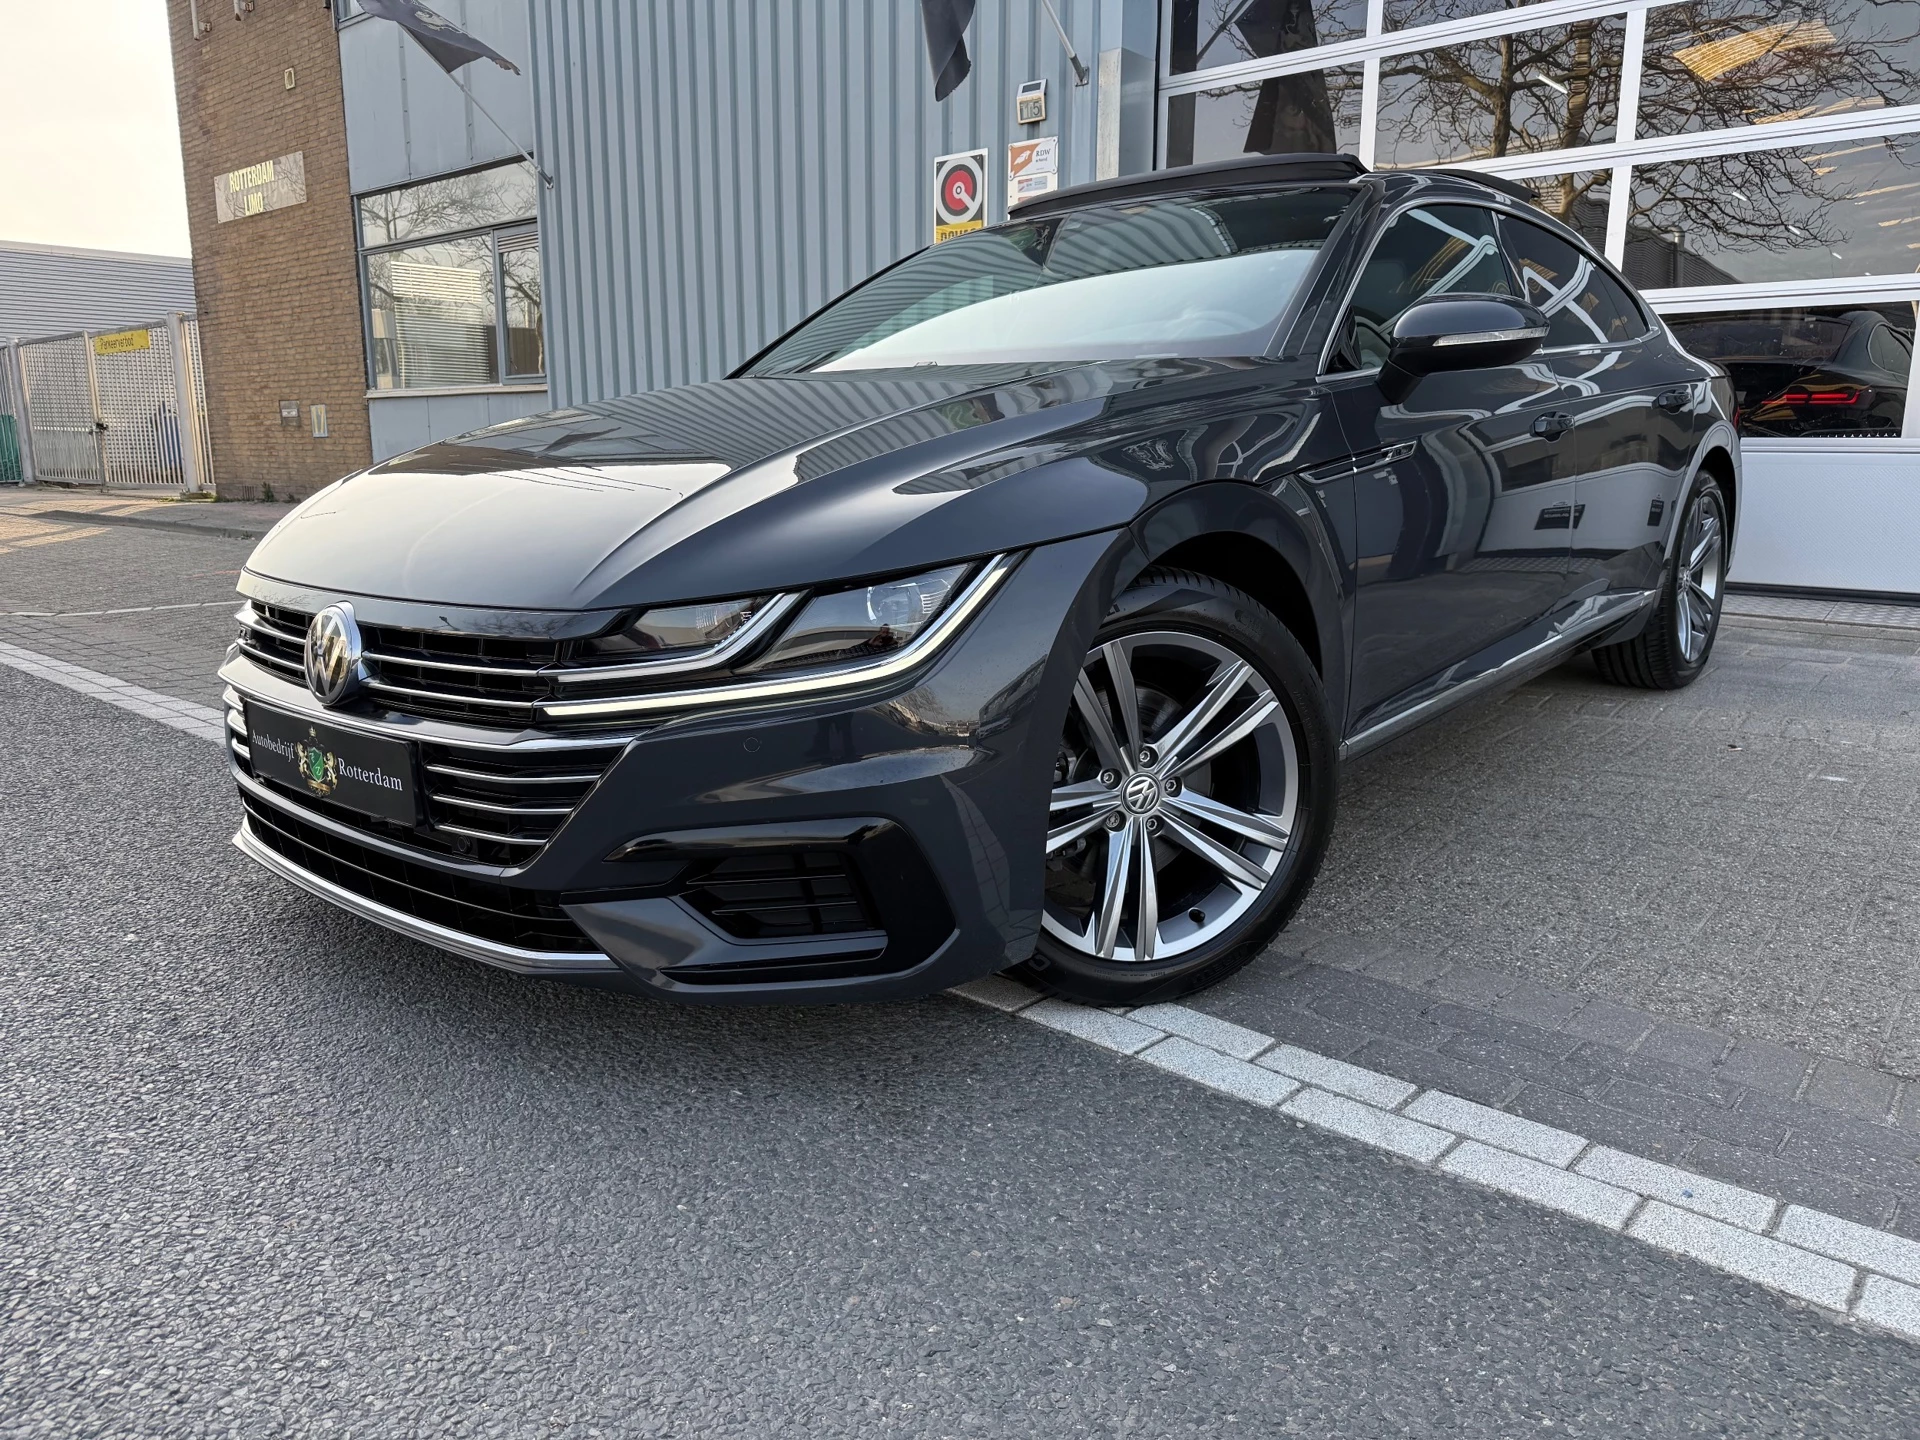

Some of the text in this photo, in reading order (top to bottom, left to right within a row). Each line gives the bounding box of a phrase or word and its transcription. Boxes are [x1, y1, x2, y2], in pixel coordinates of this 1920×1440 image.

[1024, 101, 1041, 117] 15
[1036, 148, 1051, 157] RDW
[228, 160, 275, 193] ROTTERDAM
[243, 191, 264, 216] LIMO
[252, 729, 295, 762] Autobedrijf
[337, 757, 403, 791] Rotterdam
